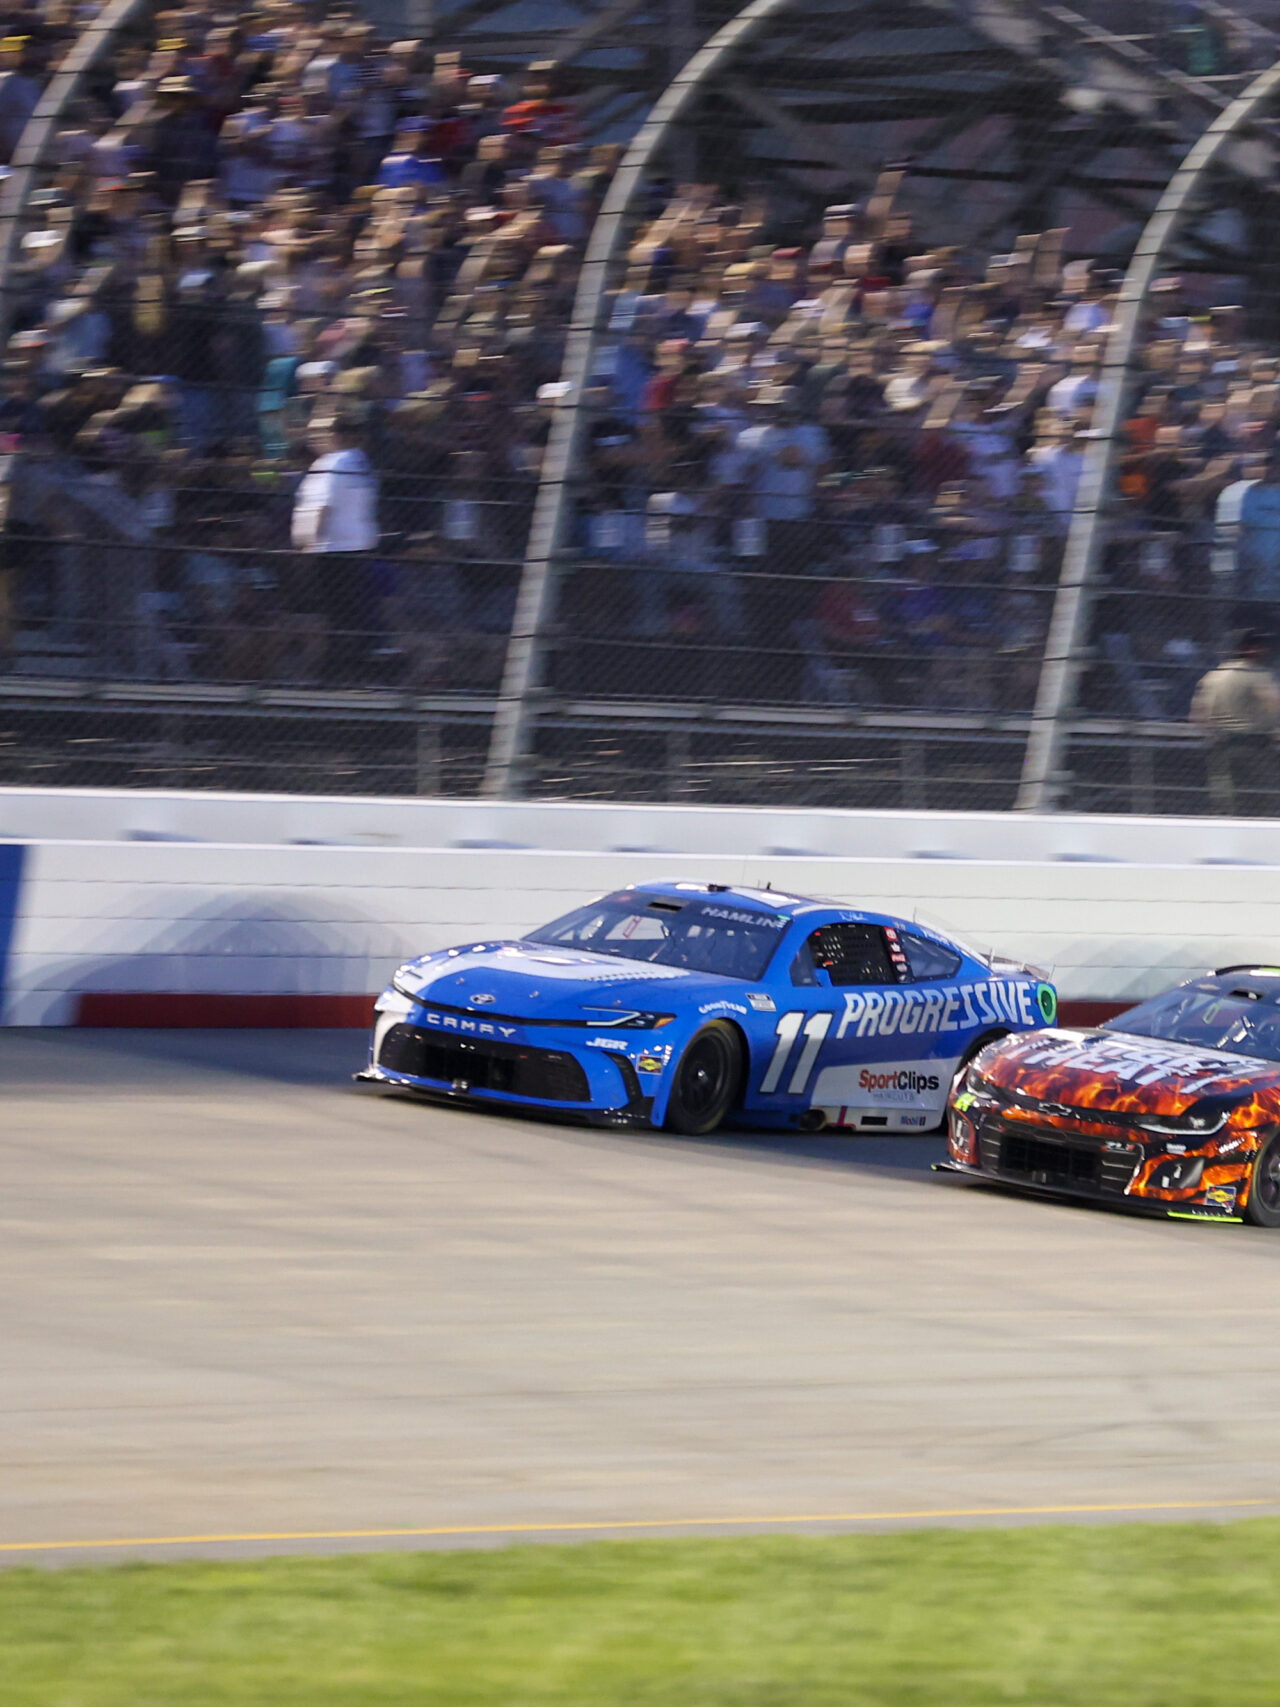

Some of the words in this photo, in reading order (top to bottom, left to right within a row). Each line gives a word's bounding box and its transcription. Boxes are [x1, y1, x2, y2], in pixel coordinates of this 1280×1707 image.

[837, 981, 1035, 1040] PROGRESSIVE
[426, 1013, 516, 1038] CAMRY
[586, 1037, 628, 1050] JGR
[760, 1012, 832, 1094] 11
[859, 1069, 940, 1093] SportClips
